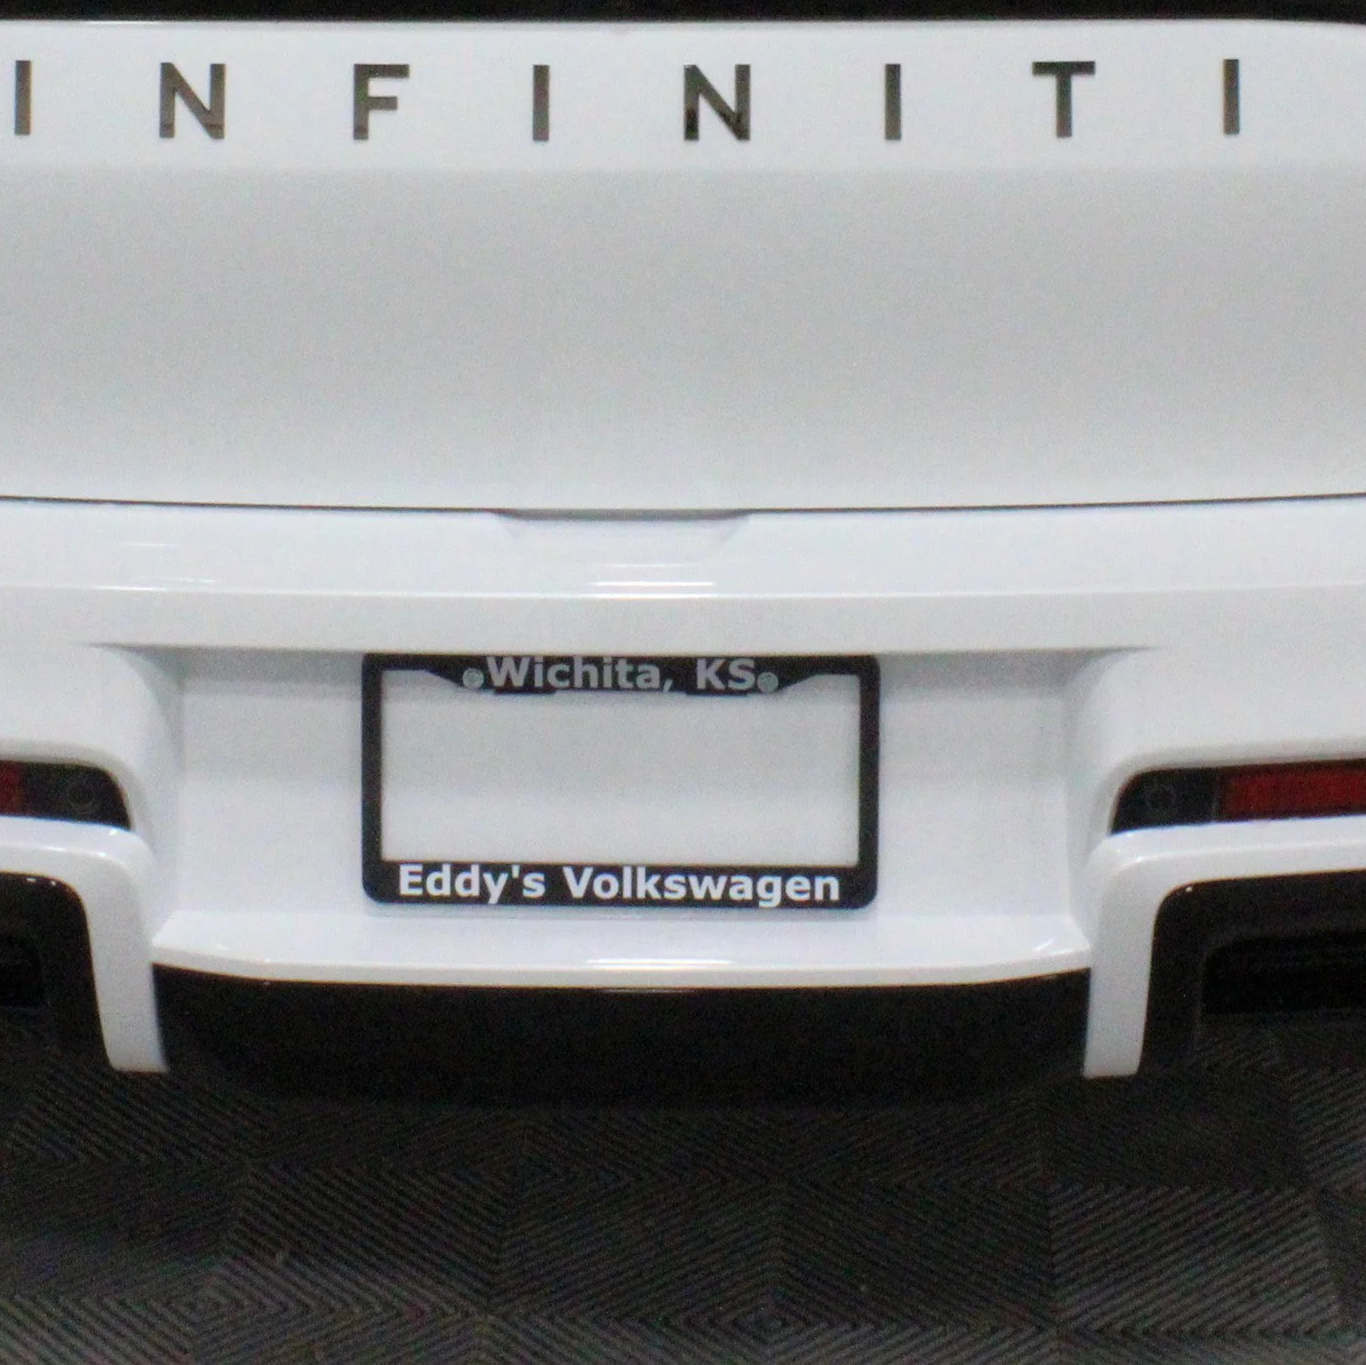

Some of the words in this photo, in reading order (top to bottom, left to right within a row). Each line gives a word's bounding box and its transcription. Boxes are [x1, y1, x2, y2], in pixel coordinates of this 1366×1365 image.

[14, 58, 1240, 142] INFINITI
[487, 655, 673, 692] Wichita,
[696, 658, 756, 691] KS
[398, 863, 546, 905] Eddy's
[562, 865, 841, 909] Volkswagen
